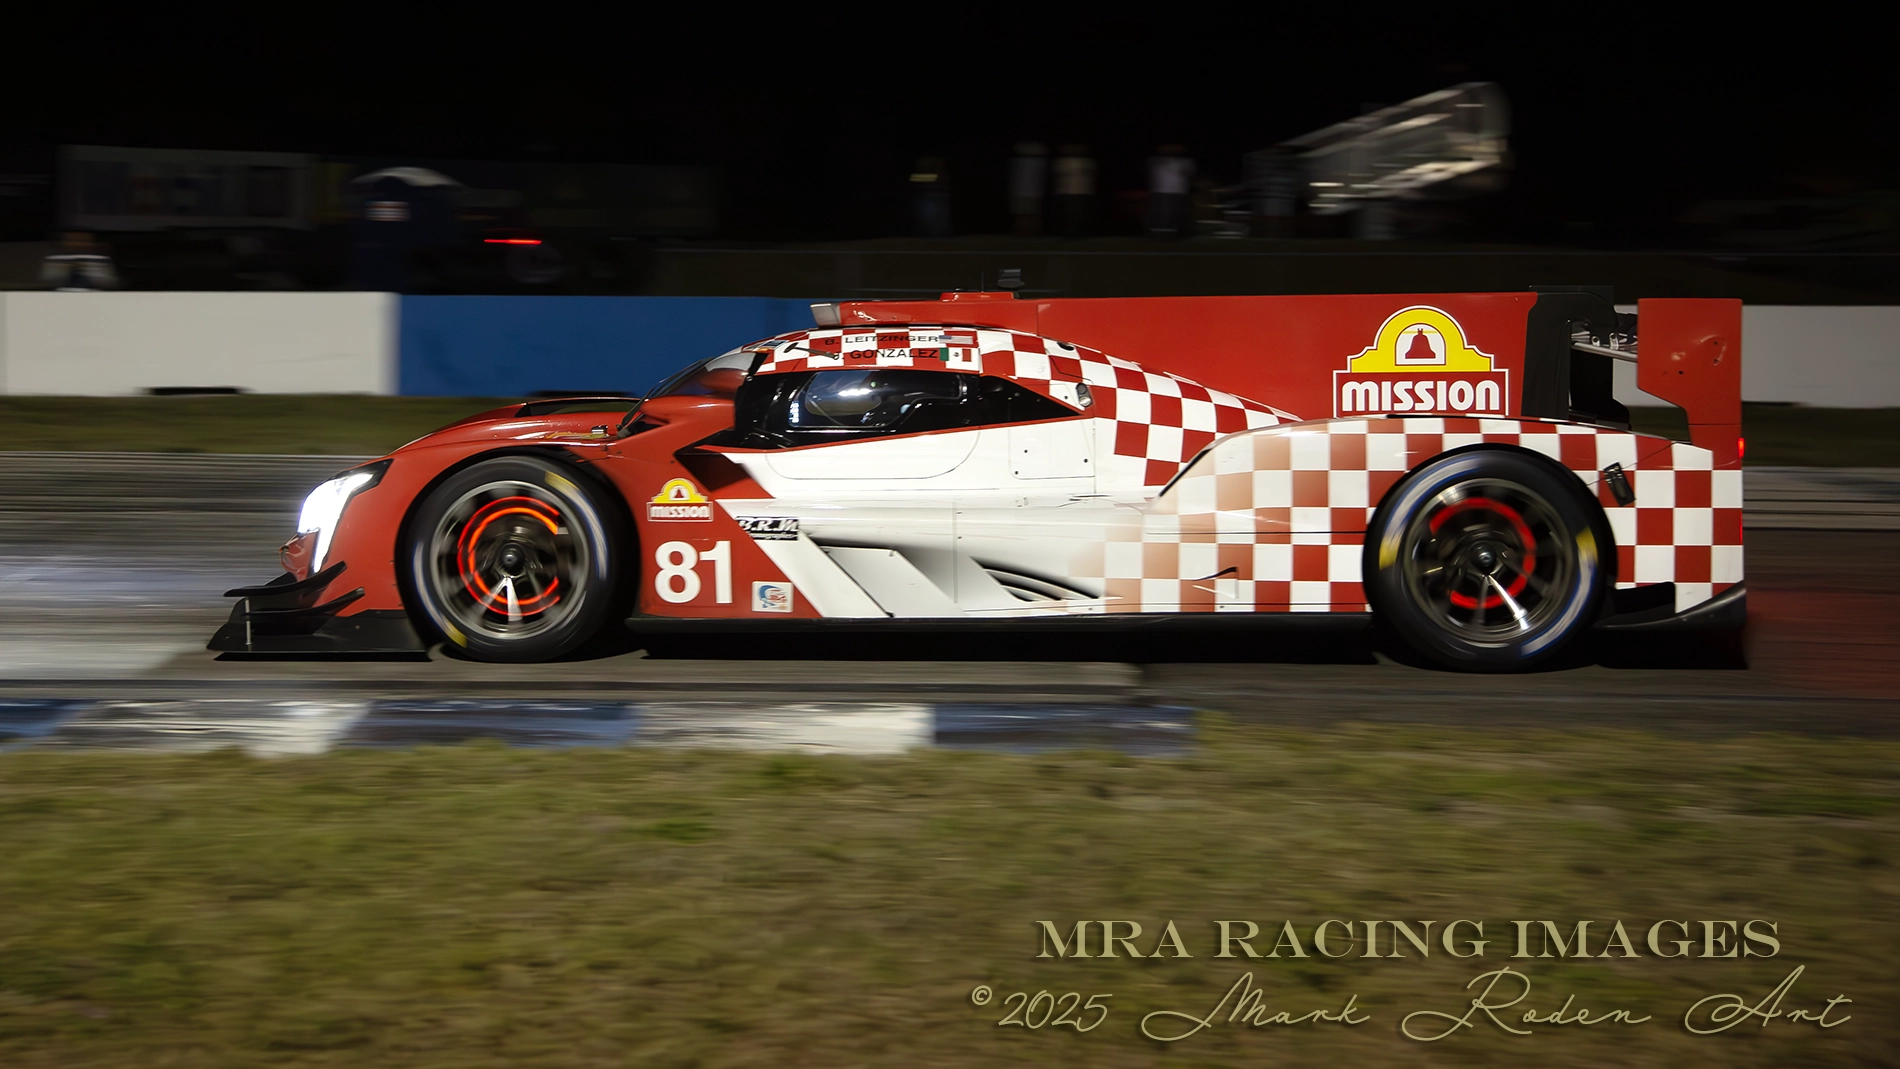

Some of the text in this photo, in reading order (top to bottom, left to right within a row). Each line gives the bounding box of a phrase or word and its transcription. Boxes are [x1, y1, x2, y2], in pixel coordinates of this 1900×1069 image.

[845, 335, 938, 343] LEITZINGER
[849, 348, 938, 359] GONZALEZ
[1342, 380, 1500, 412] MISSION
[650, 506, 710, 518] MISSION
[654, 540, 733, 604] 81
